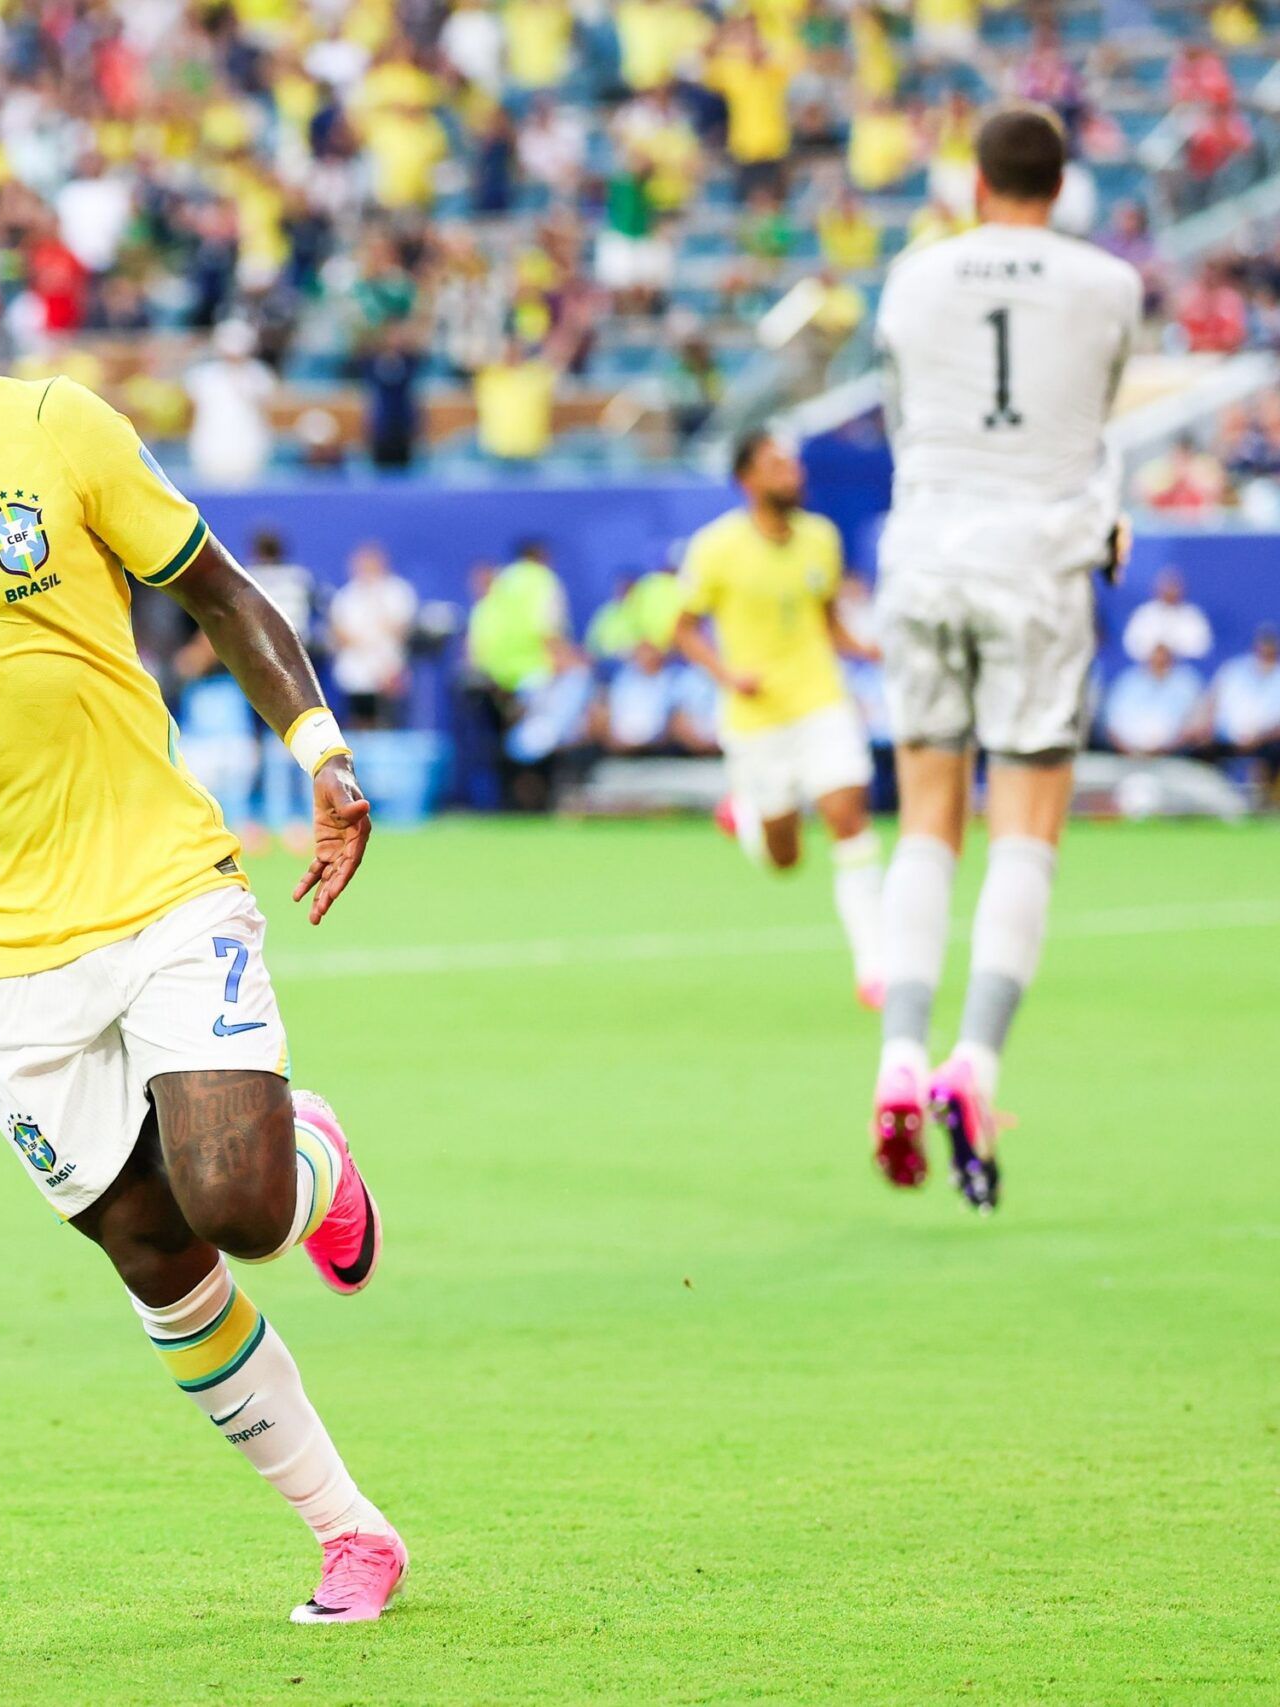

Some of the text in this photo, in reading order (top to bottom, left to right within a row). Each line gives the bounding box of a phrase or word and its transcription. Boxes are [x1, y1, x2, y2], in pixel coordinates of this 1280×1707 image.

[984, 307, 1022, 429] 1
[7, 531, 30, 546] CBF
[5, 573, 62, 603] BRASIL
[212, 936, 249, 1003] 7
[225, 1419, 276, 1445] BRASIL
